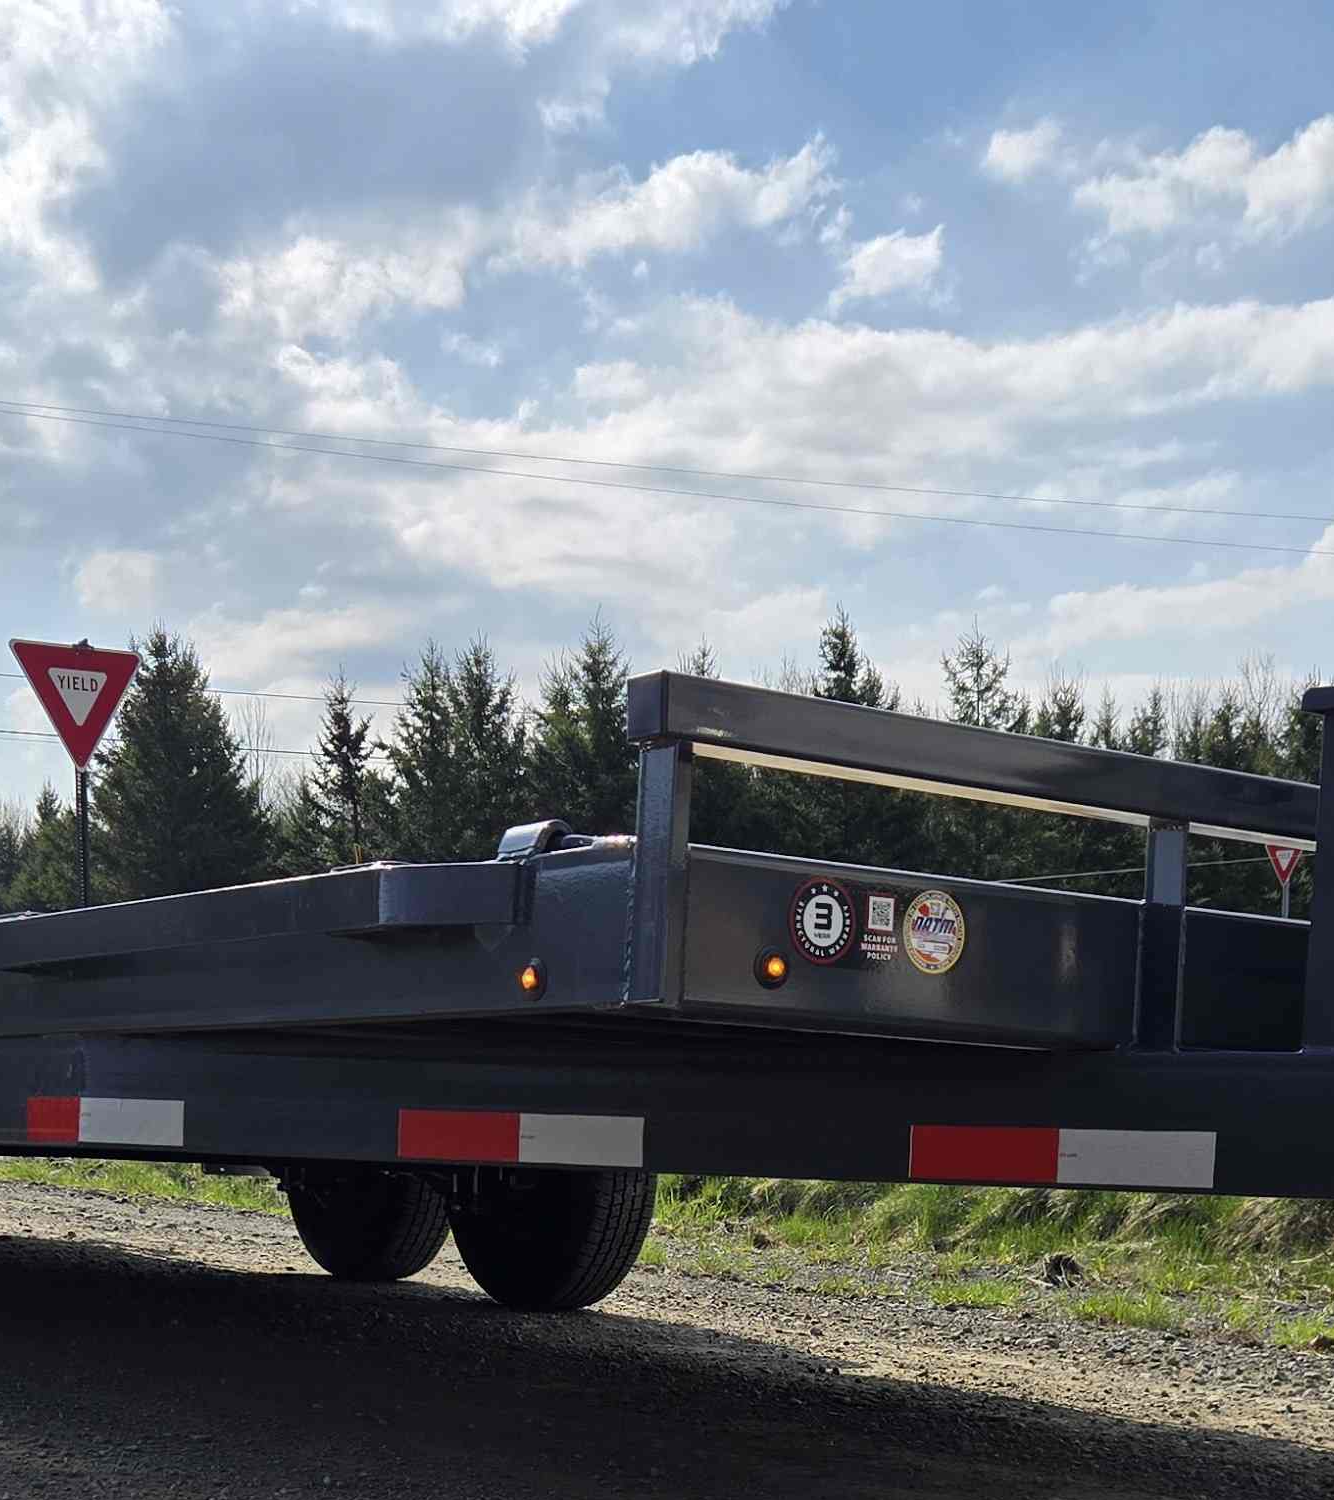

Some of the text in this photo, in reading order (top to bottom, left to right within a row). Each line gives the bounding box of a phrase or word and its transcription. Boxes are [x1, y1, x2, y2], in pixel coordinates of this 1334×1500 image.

[57, 674, 98, 692] YIELD
[814, 902, 833, 930] 3
[863, 934, 897, 944] SCAN FOR
[860, 942, 898, 953] WARRANTY
[866, 952, 892, 961] POLICY
